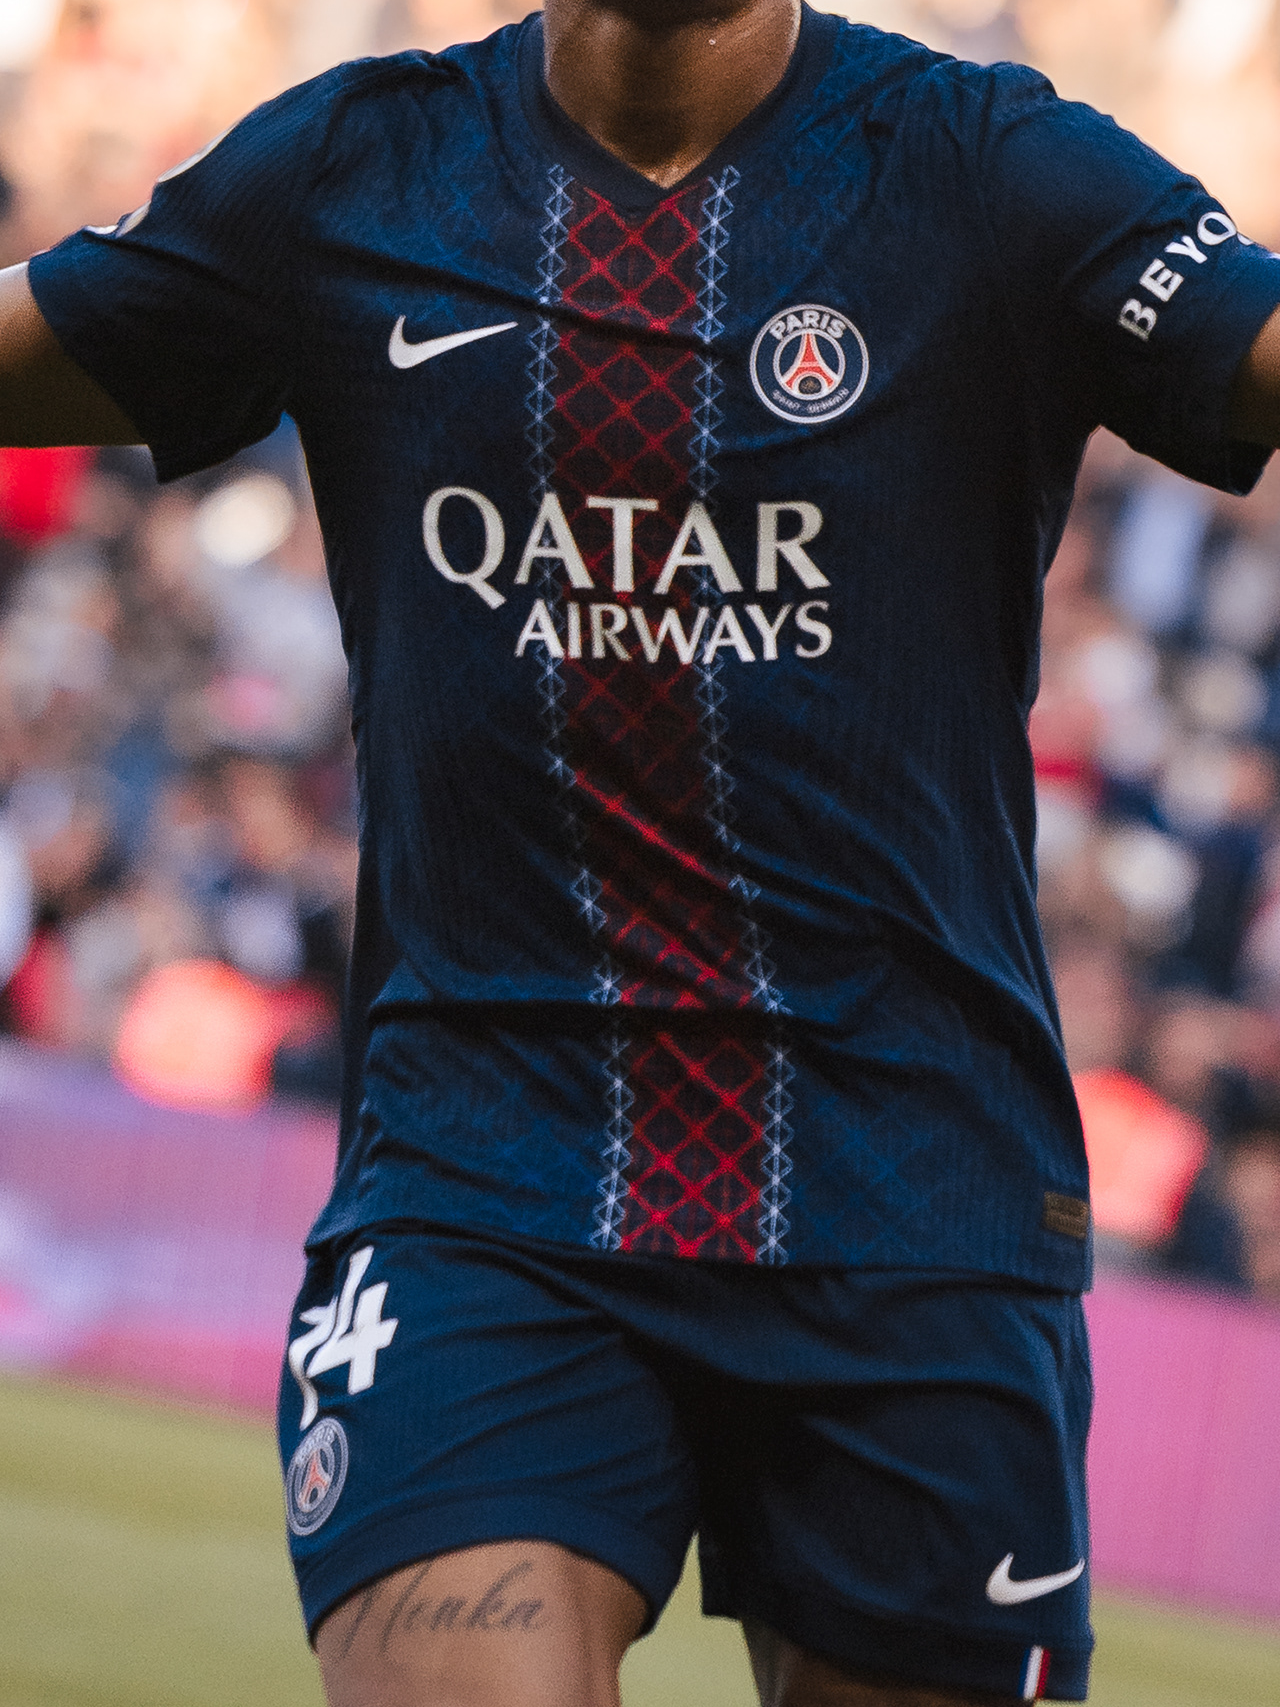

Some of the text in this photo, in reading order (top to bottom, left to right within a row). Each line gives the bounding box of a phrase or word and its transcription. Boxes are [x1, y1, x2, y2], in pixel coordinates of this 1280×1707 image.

[1118, 211, 1256, 342] BEYO
[769, 310, 847, 340] PARIS
[422, 486, 830, 608] QATAR
[514, 598, 833, 664] AIRWAYS
